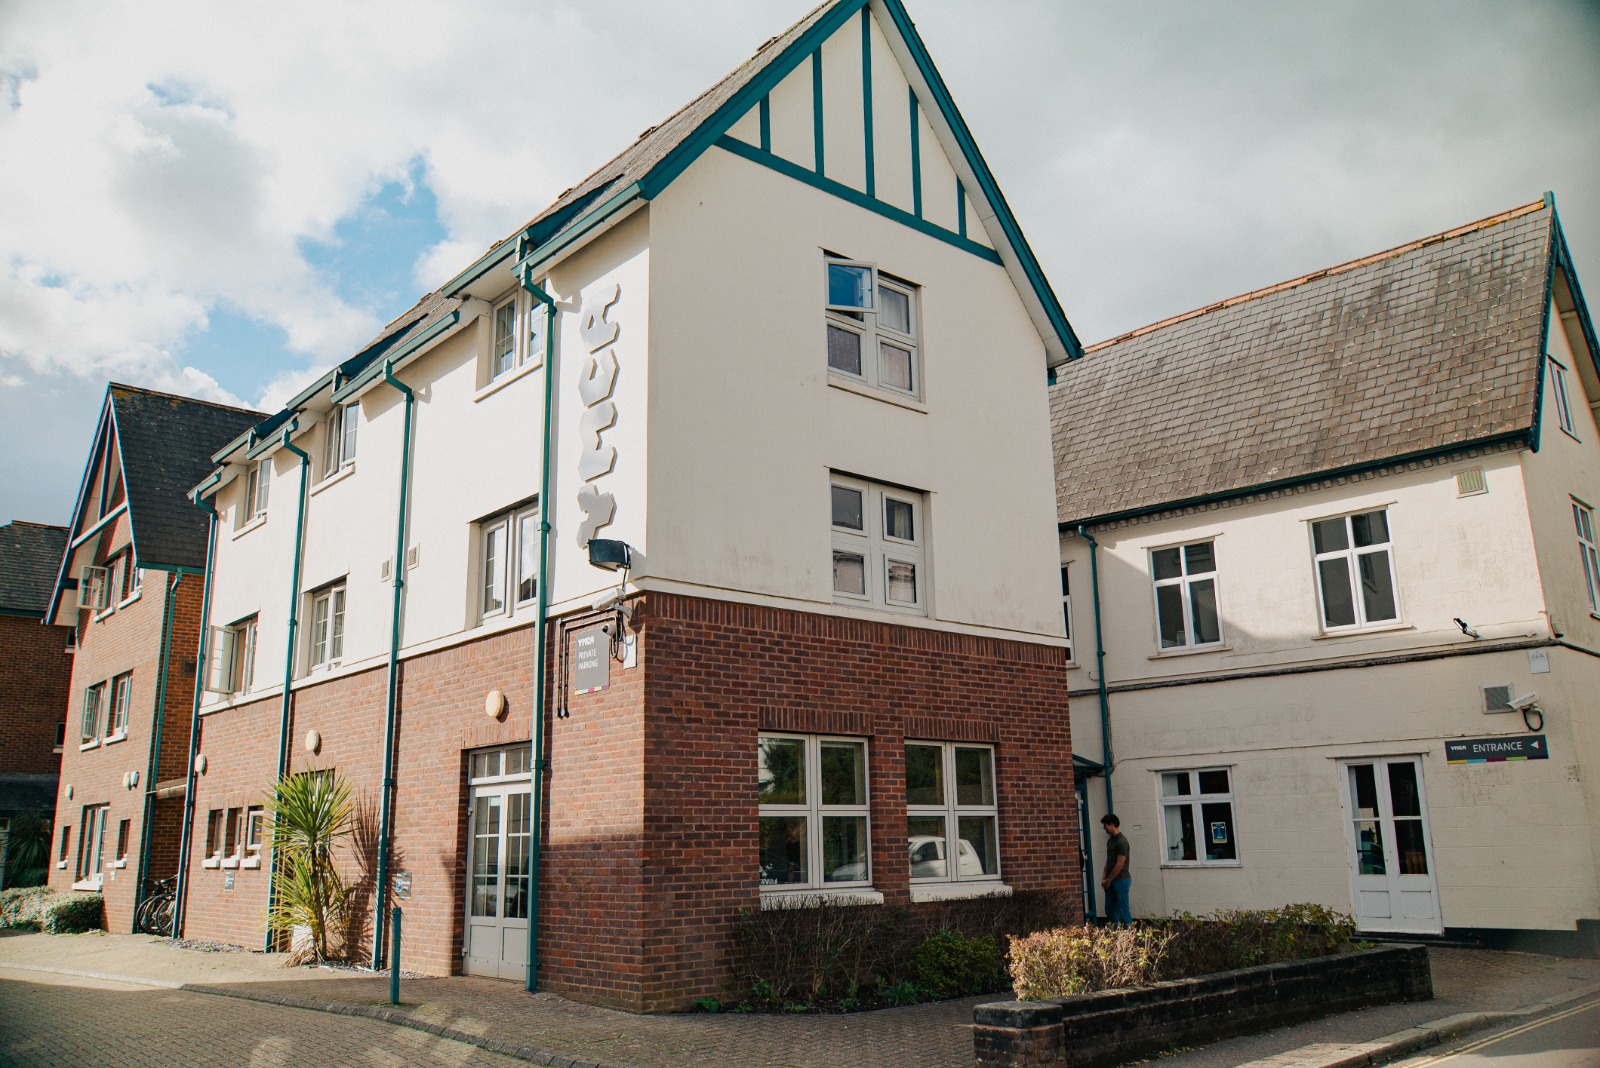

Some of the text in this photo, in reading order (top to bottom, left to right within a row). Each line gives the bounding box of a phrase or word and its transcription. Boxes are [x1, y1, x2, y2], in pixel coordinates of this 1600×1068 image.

[578, 635, 594, 647] YMCA
[578, 648, 597, 659] PRIVATE
[578, 660, 598, 670] PARKING
[1472, 741, 1523, 753] ENTRANCE
